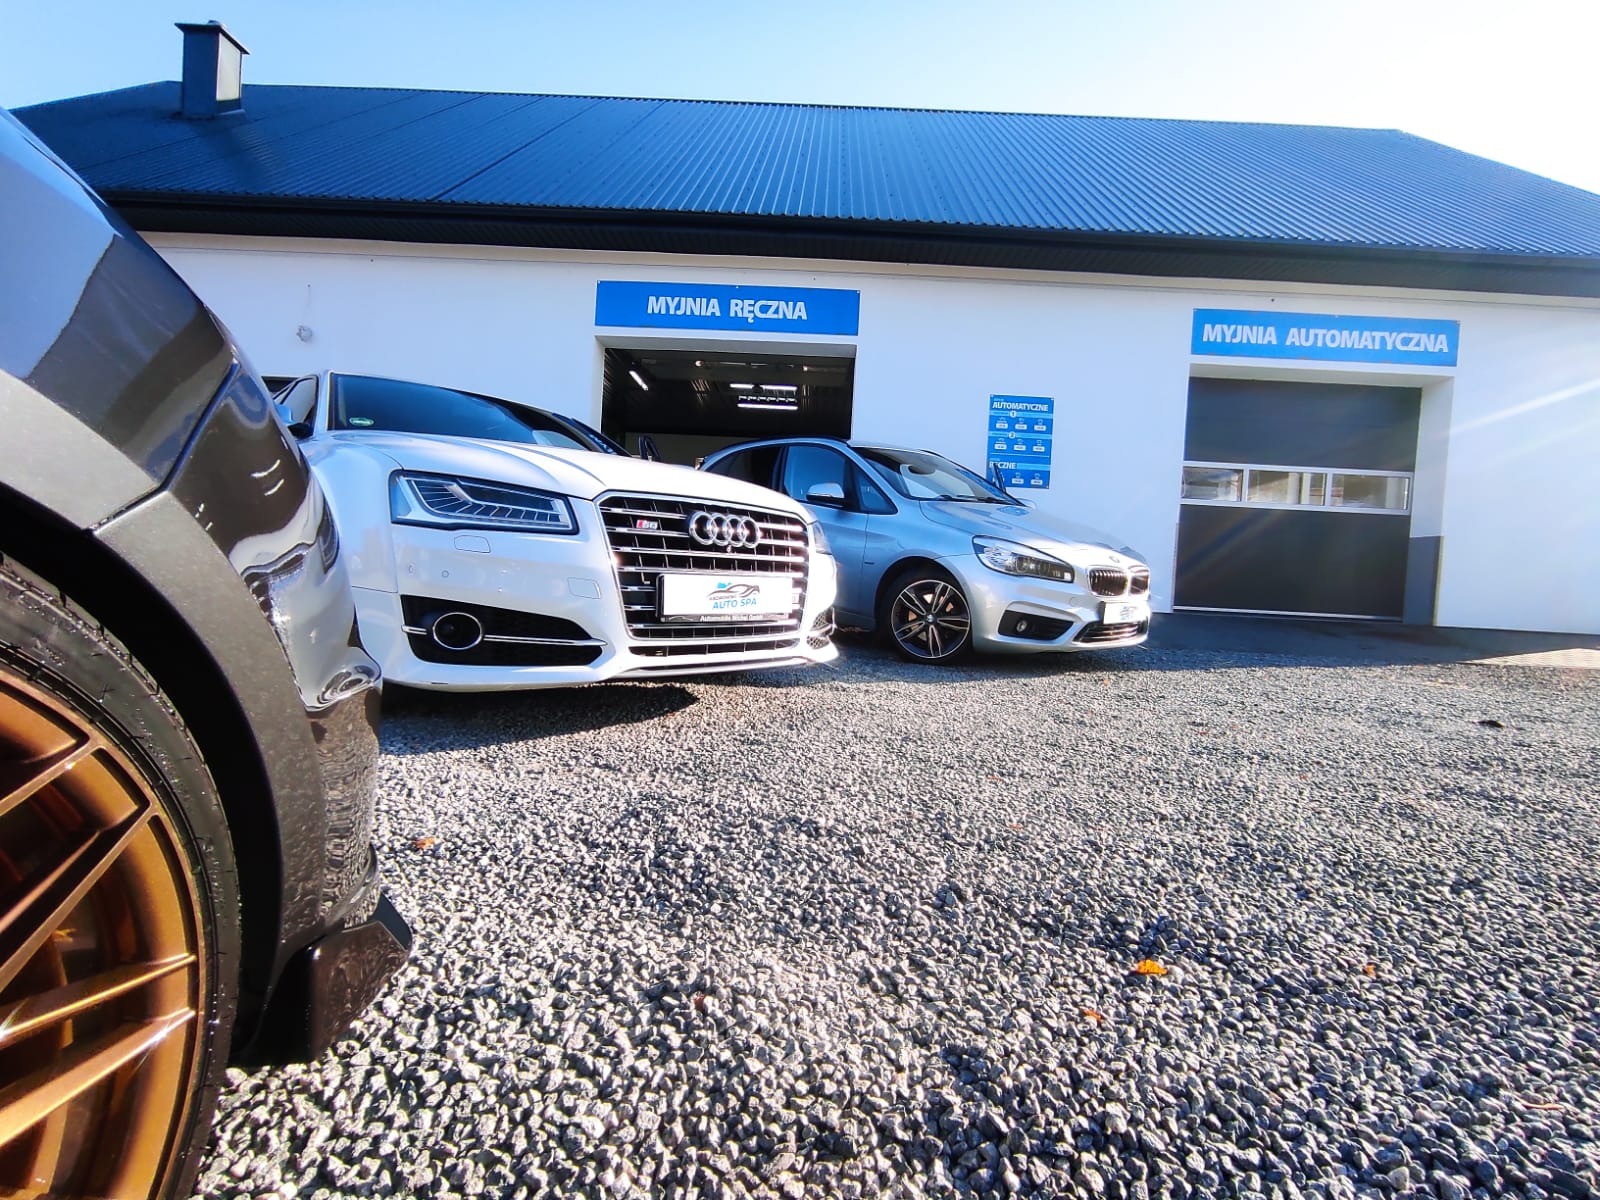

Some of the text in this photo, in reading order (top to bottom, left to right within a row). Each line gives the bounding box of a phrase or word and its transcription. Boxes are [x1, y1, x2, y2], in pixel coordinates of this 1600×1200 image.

[647, 295, 808, 323] MYJNIA RĘCZNA
[1202, 323, 1449, 353] MYJNIA AUTOMATYCZNA
[992, 401, 1049, 412] AUTOMATYCZNE
[712, 599, 738, 609] AUTO
[740, 597, 757, 607] SPA
